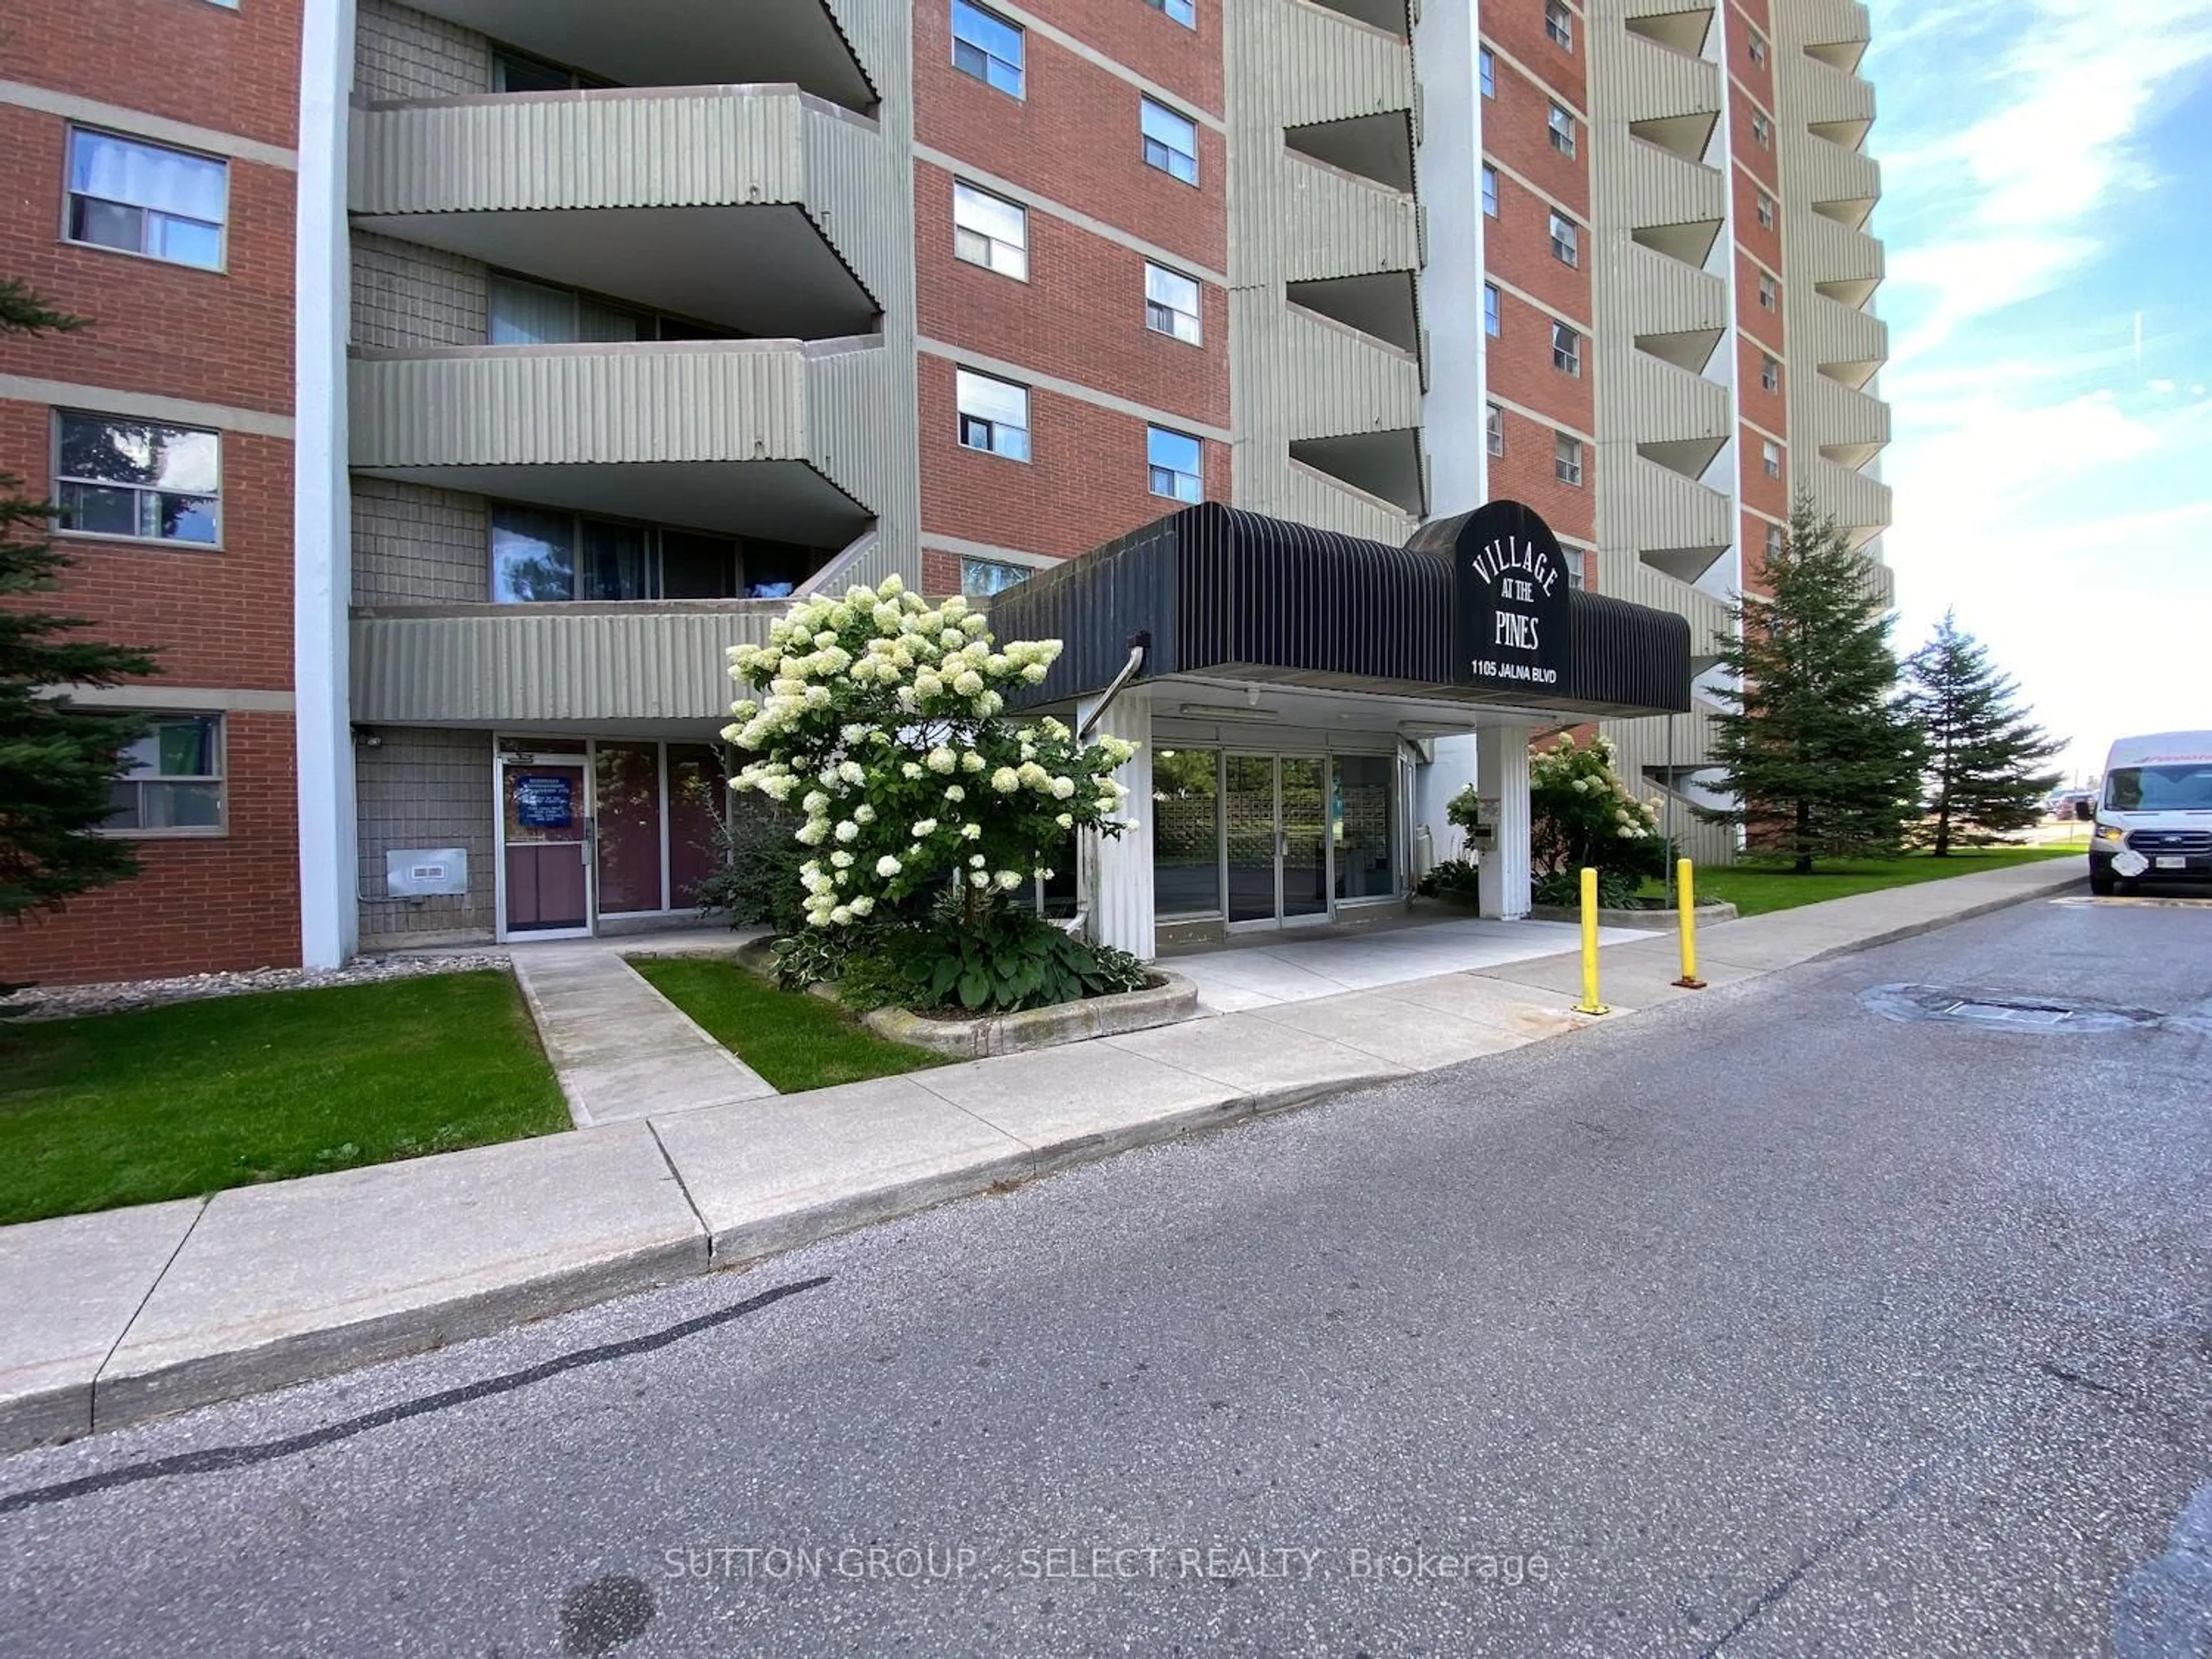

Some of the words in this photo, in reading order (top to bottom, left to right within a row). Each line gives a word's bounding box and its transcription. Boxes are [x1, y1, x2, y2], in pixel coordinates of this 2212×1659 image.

[1472, 536, 1558, 597] VILLAGE
[1501, 578, 1514, 599] AT
[1515, 579, 1534, 602] THE
[1495, 611, 1539, 650] PINES
[1472, 660, 1497, 676] 1105
[1498, 664, 1531, 681] JALNA
[1532, 667, 1556, 684] BLVD
